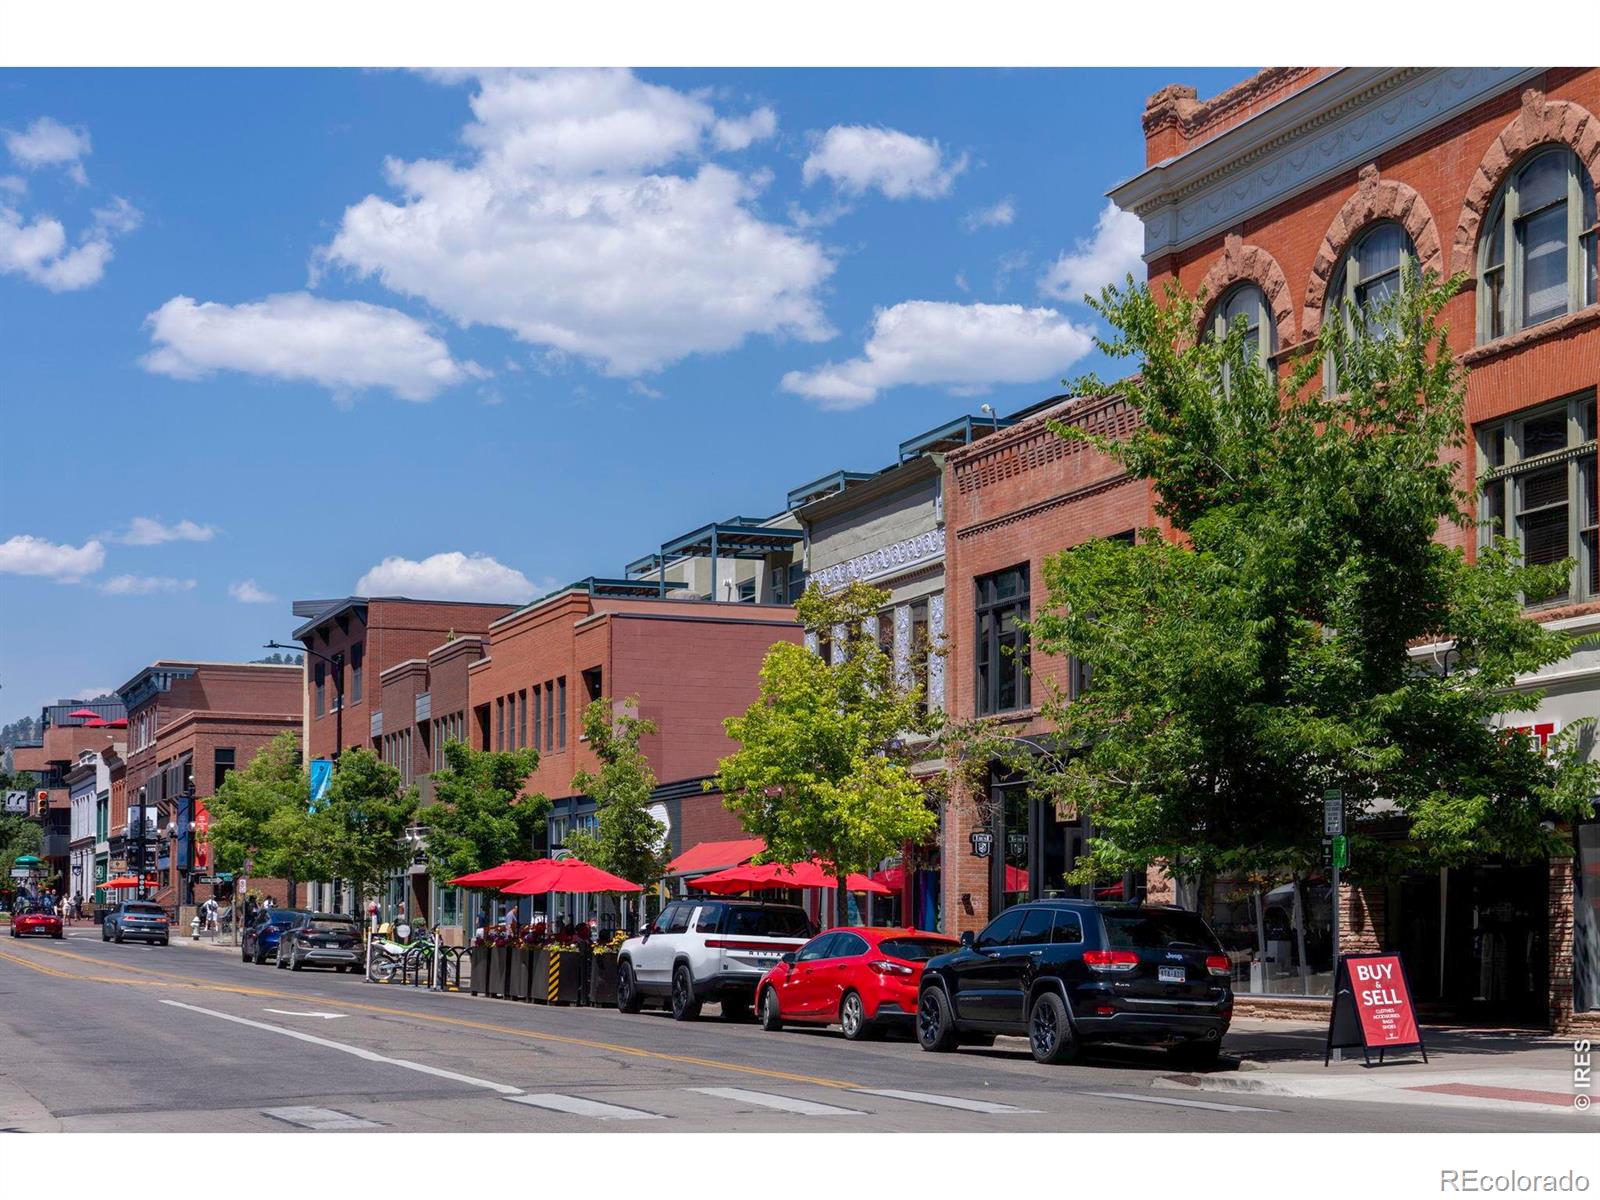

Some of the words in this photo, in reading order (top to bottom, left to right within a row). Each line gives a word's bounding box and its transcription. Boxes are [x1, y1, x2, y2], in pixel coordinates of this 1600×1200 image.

[1165, 952, 1183, 961] Jeep
[1357, 963, 1392, 981] BUY
[1375, 981, 1382, 989] &
[1362, 988, 1403, 1006] SELL
